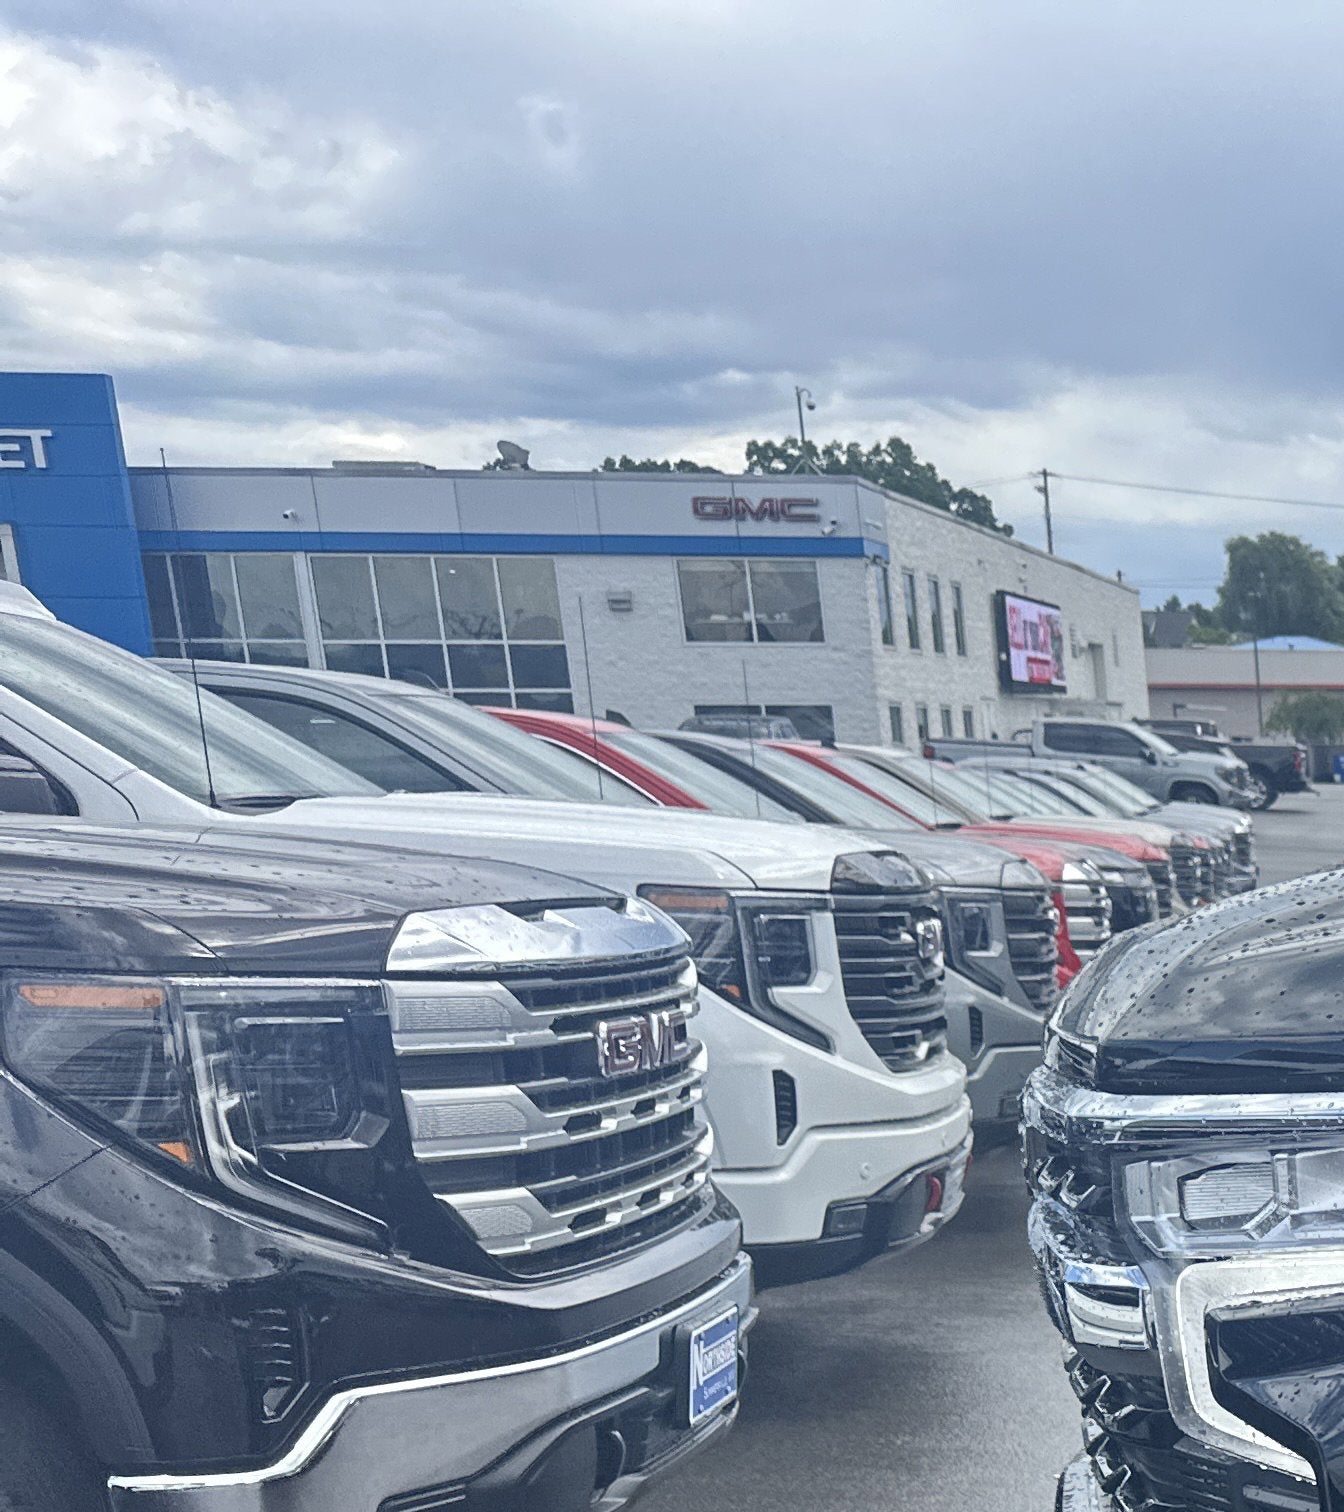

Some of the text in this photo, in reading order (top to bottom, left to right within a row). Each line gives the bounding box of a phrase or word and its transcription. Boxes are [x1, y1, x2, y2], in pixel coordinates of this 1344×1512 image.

[692, 496, 821, 522] GMC
[598, 1008, 690, 1078] GMC
[692, 1335, 737, 1391] NORTHSIDE
